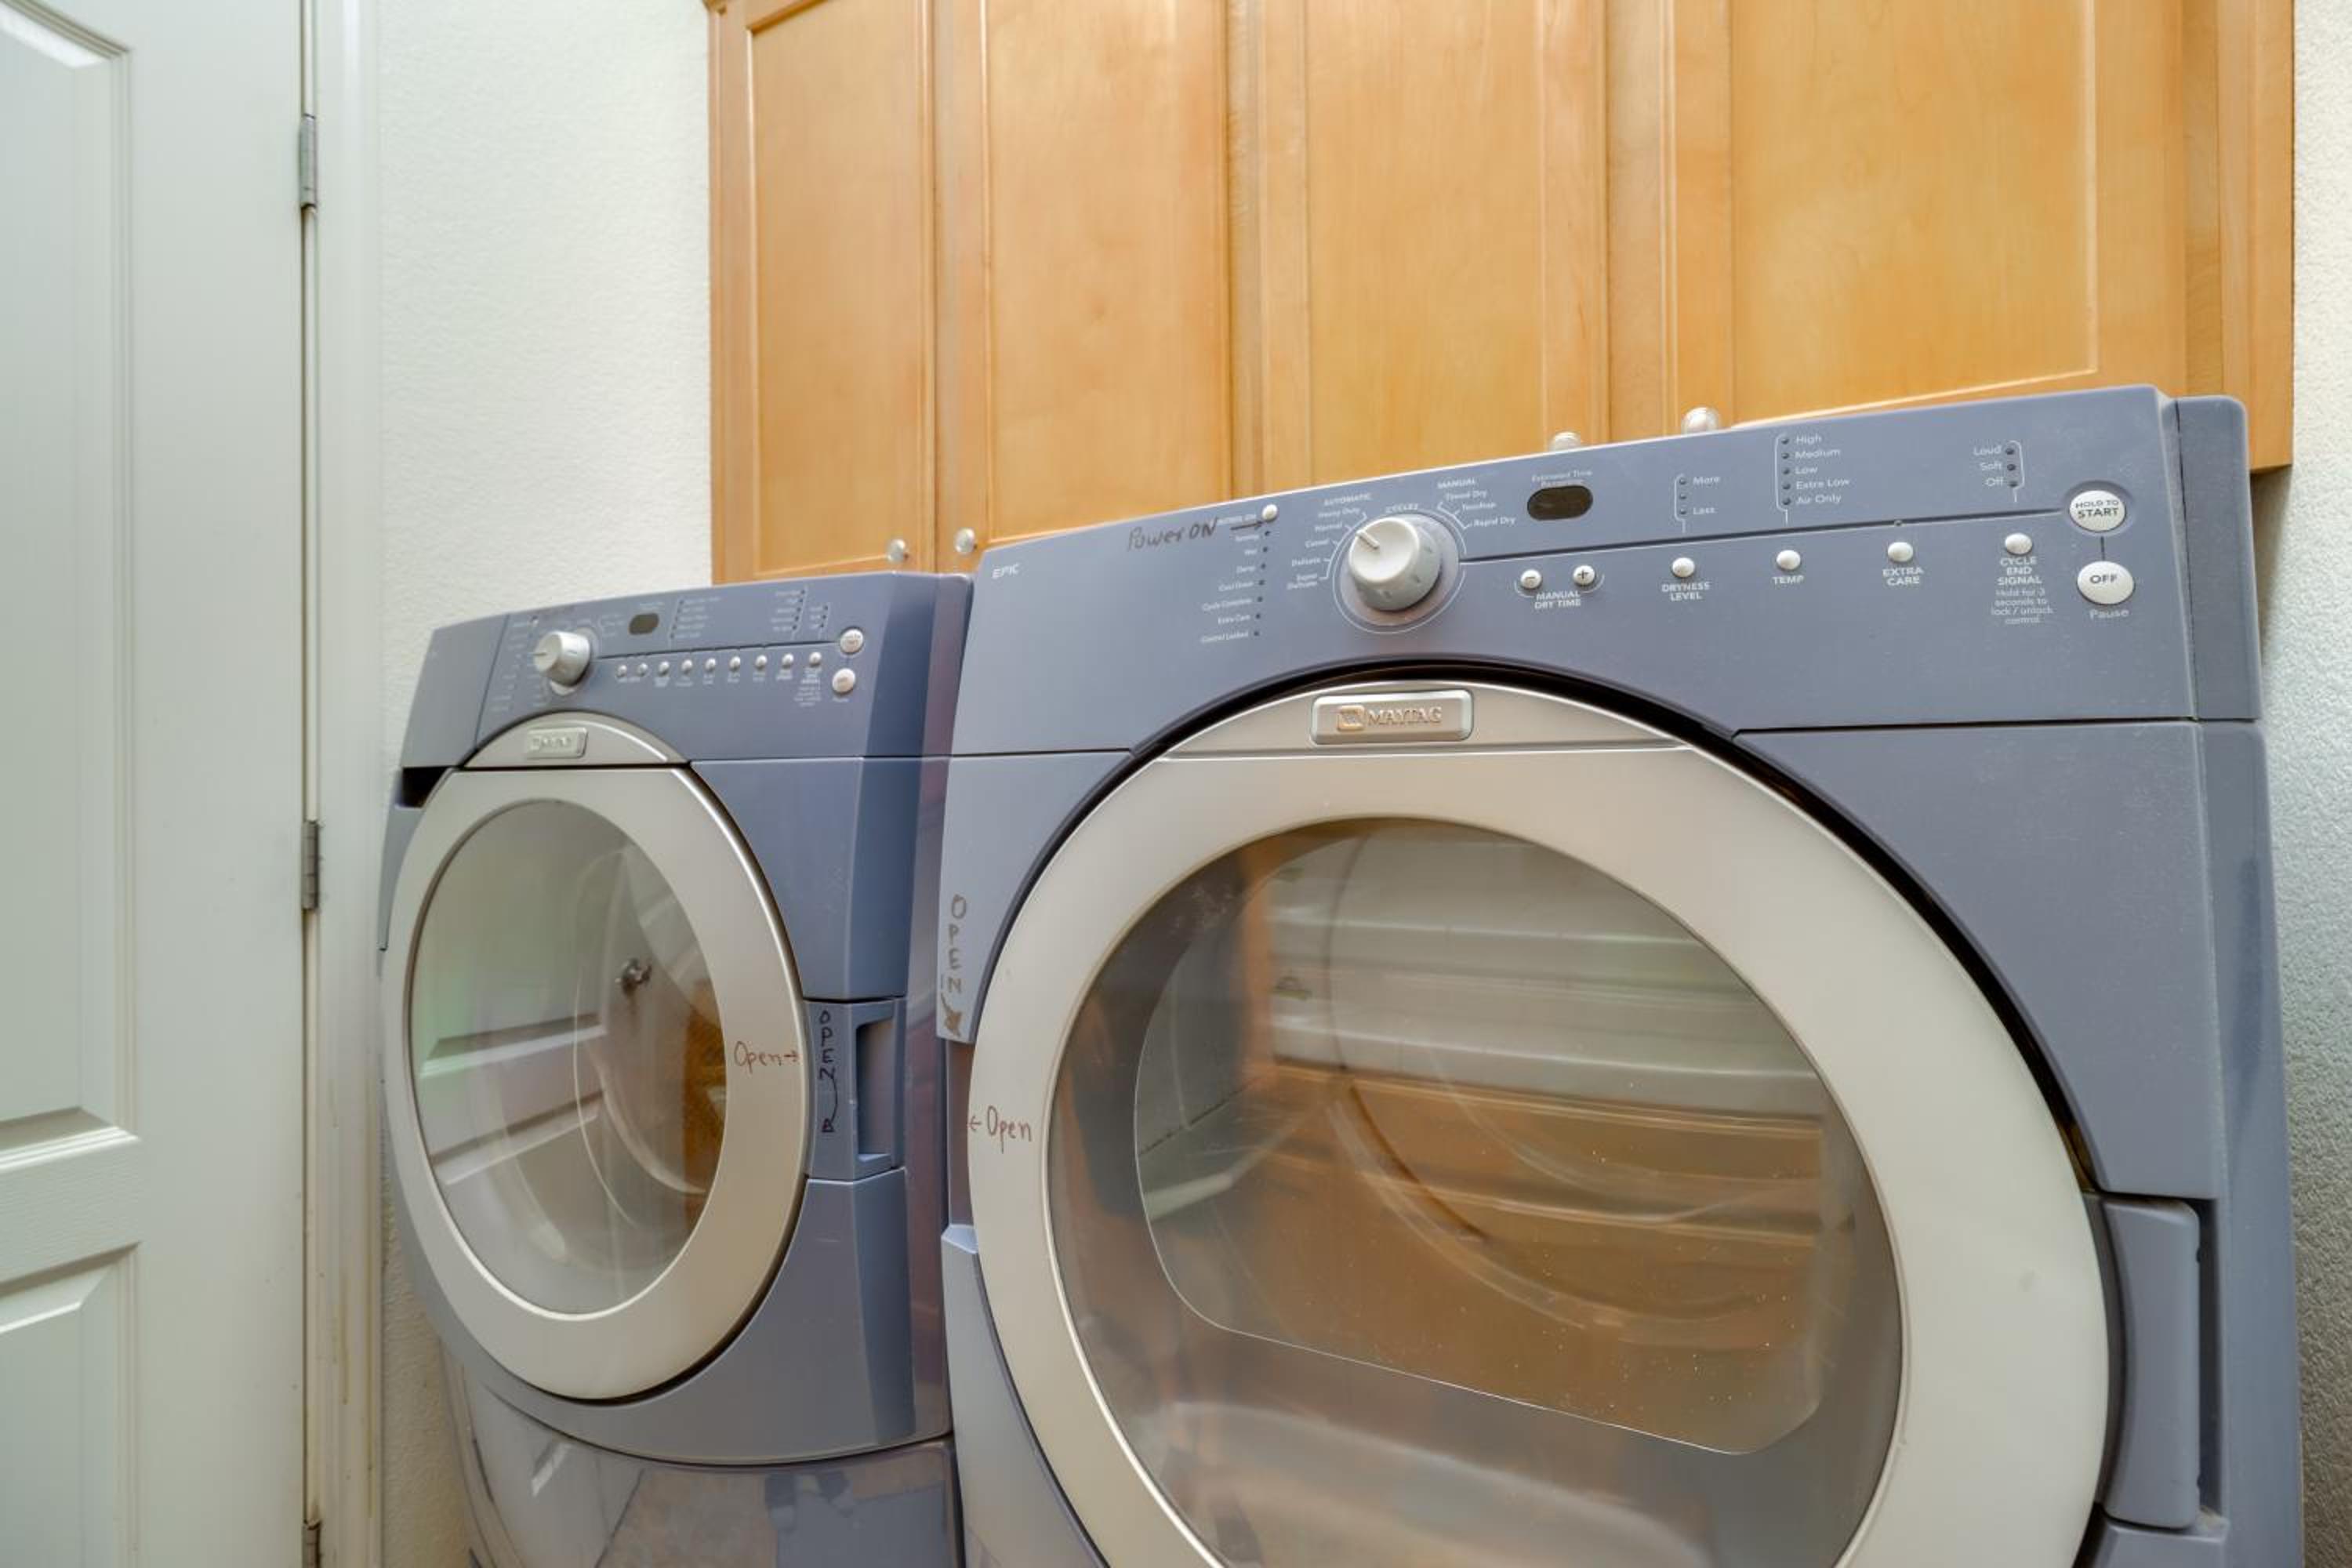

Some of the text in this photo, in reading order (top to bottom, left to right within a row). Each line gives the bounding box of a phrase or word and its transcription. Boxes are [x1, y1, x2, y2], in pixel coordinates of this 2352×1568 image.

[1796, 434, 1821, 446] High
[1795, 448, 1841, 459] Medium
[1974, 446, 2002, 456] Loud
[1795, 465, 1818, 475] Low
[1795, 477, 1849, 490] Extra Low
[2076, 500, 2103, 509] HOLD
[2078, 507, 2118, 518] START
[1189, 518, 1218, 539] ON
[2000, 557, 2038, 567] CYCLE
[992, 563, 1019, 579] EPIC
[1882, 566, 1924, 577] EXTRA
[2006, 567, 2032, 575] END
[1773, 575, 1805, 586] TEMP
[1886, 575, 1921, 586] CARE
[1998, 576, 2042, 586] SIGNAL
[2090, 574, 2118, 584] OFF
[1661, 582, 1711, 593] DRYNESS
[1535, 590, 1581, 601] MANUAL
[1671, 591, 1703, 602] LEVEL
[1534, 598, 1582, 610] DRY TIME
[2089, 608, 2130, 620] Pause
[1368, 706, 1443, 726] MAYTAG
[947, 894, 968, 994] OPEN
[818, 1010, 836, 1081] OPEN
[734, 1040, 782, 1076] Open
[986, 1105, 1032, 1154] Open
